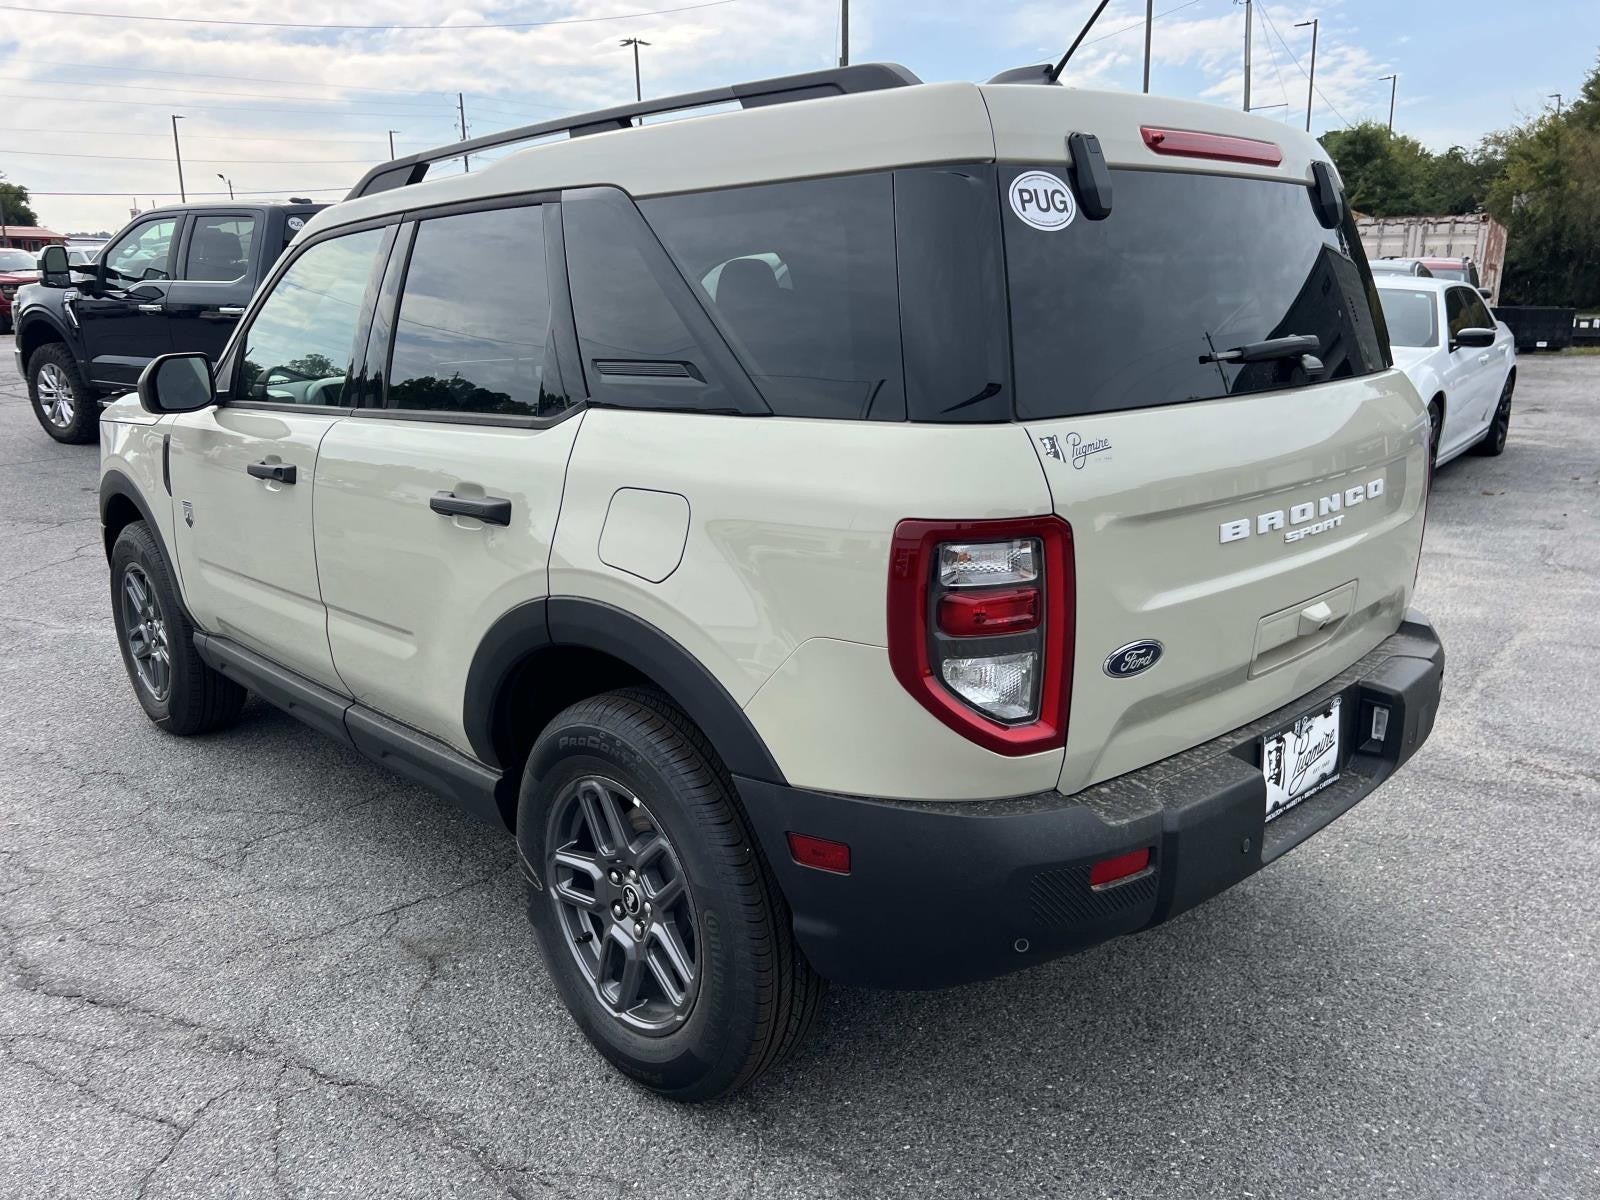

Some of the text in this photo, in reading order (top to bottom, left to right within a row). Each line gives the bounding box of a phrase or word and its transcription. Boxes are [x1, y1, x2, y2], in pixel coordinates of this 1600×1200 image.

[1017, 188, 1069, 214] PUG
[1065, 432, 1112, 470] Pugmire
[1219, 478, 1384, 544] BRONCO
[1284, 514, 1345, 544] SPORT
[1120, 648, 1154, 672] Ford
[1288, 724, 1336, 796] Pugmire
